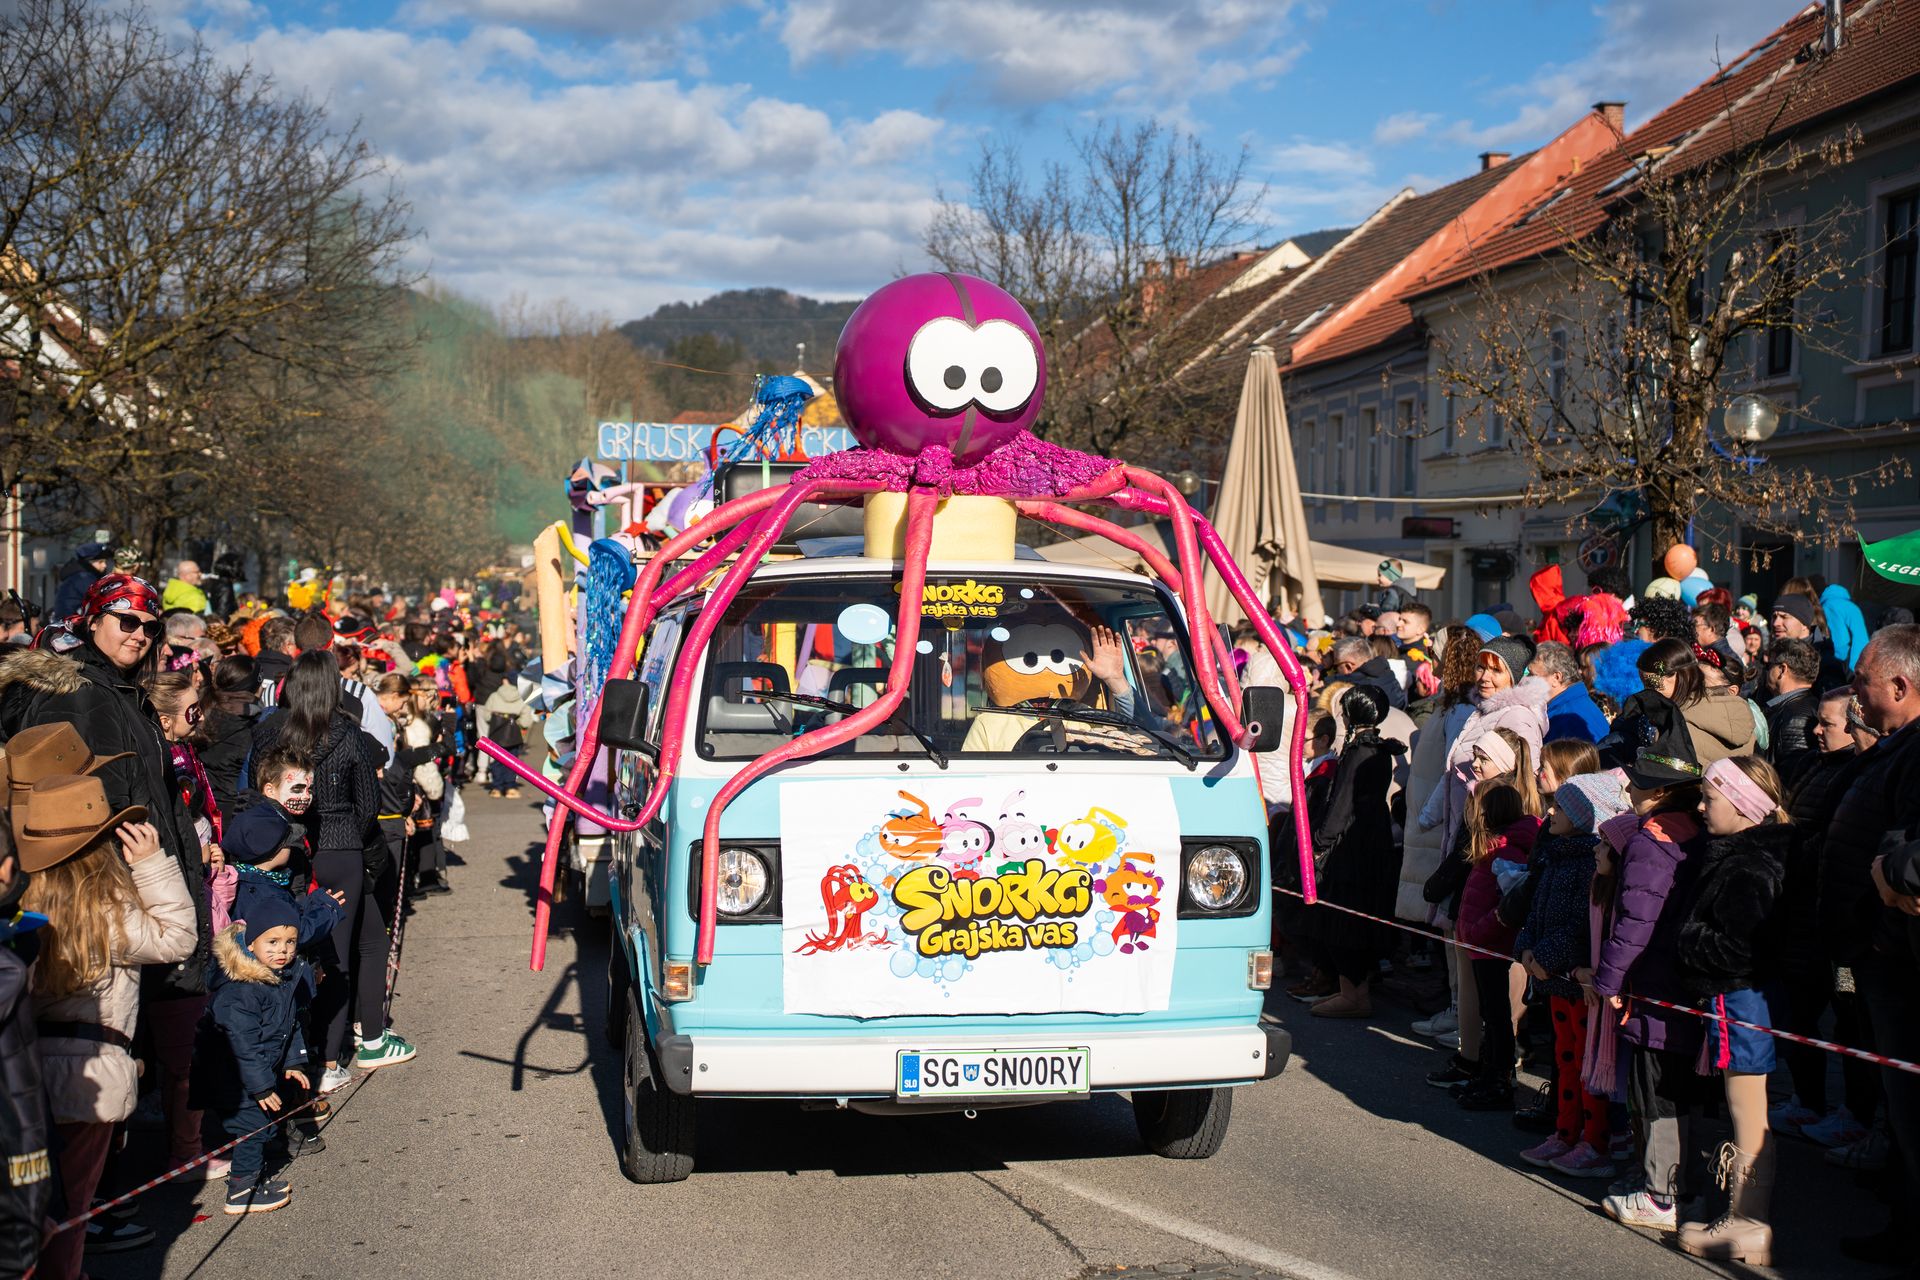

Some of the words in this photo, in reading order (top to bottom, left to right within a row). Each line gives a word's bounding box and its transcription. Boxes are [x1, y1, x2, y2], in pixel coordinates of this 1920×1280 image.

[598, 422, 716, 460] GRAJSK
[1878, 562, 1920, 577] LEGE
[893, 579, 1004, 604] NORKCI
[921, 603, 968, 617] rajska
[969, 606, 998, 617] vas
[919, 919, 1025, 957] Grajska
[1026, 922, 1077, 946] vas
[903, 1079, 918, 1089] SLO
[923, 1058, 959, 1087] SG
[983, 1056, 1082, 1087] SNOORY
